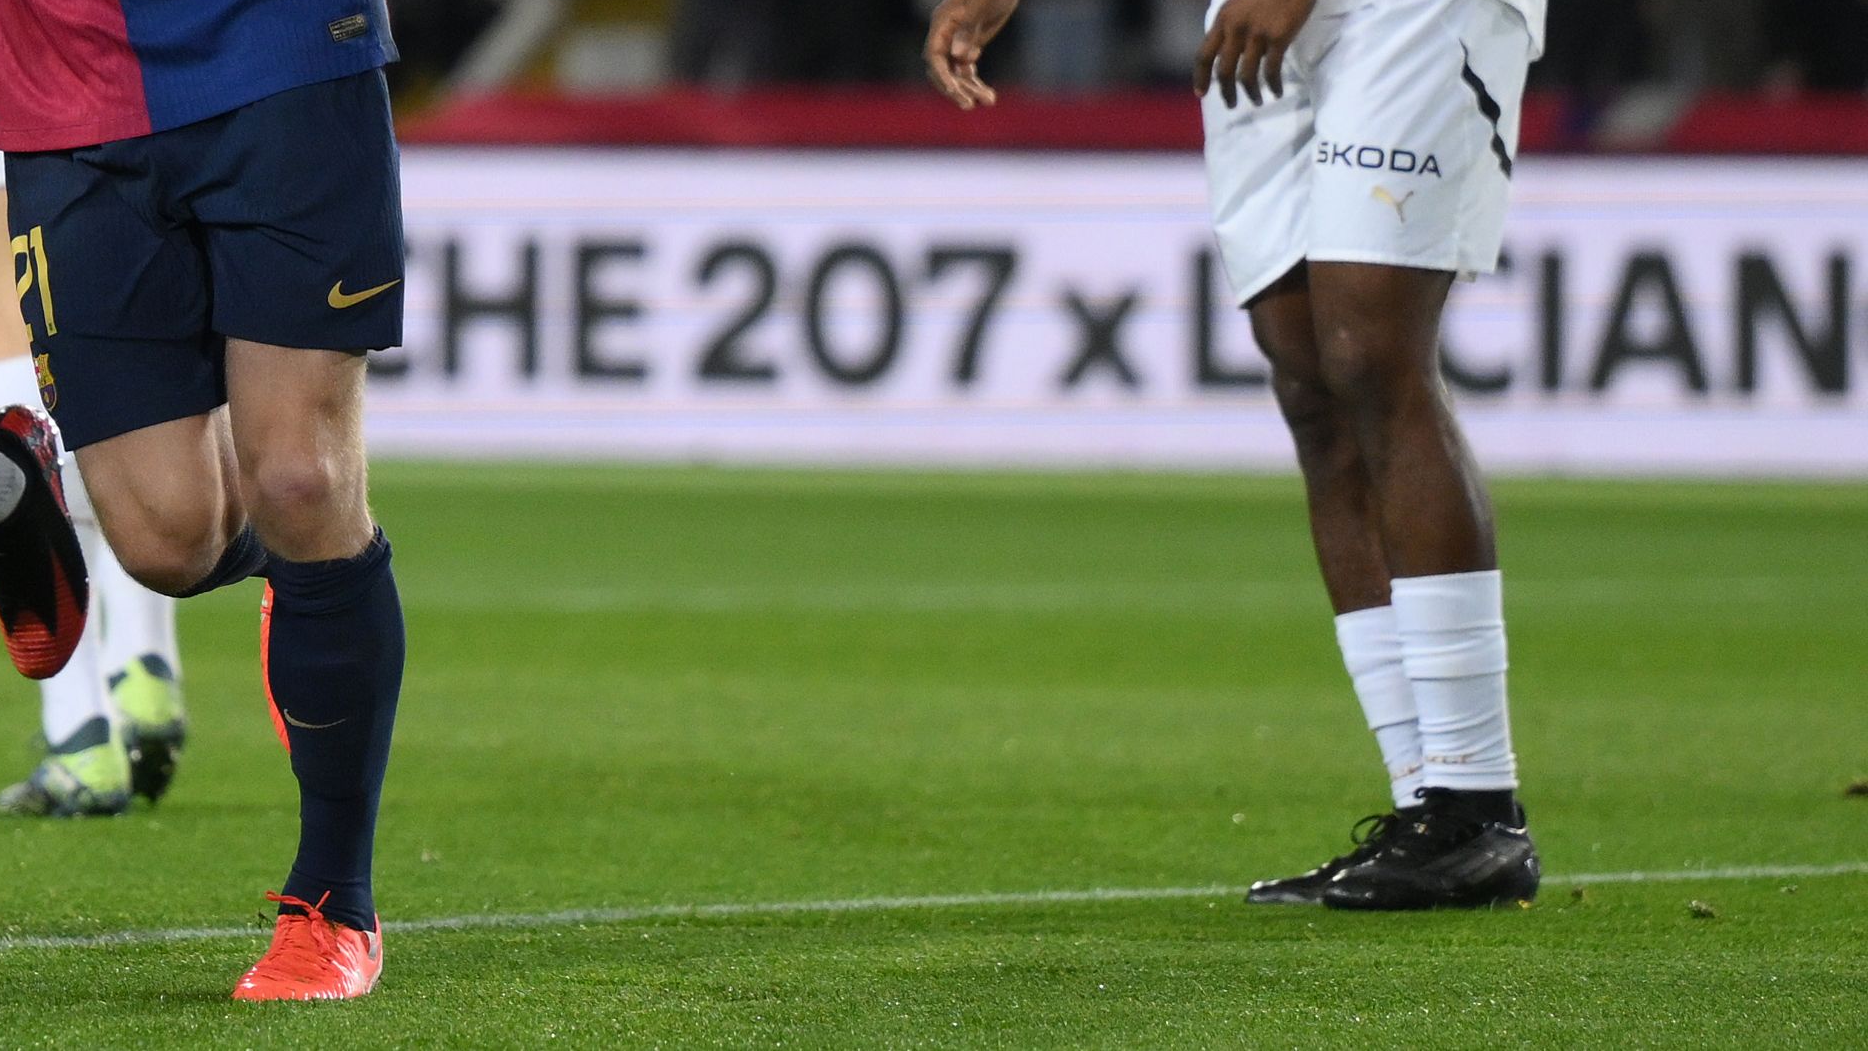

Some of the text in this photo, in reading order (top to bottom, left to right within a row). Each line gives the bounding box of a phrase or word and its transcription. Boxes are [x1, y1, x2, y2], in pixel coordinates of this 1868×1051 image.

[12, 225, 58, 342] 21
[691, 237, 1019, 387] 207
[1059, 284, 1144, 387] x
